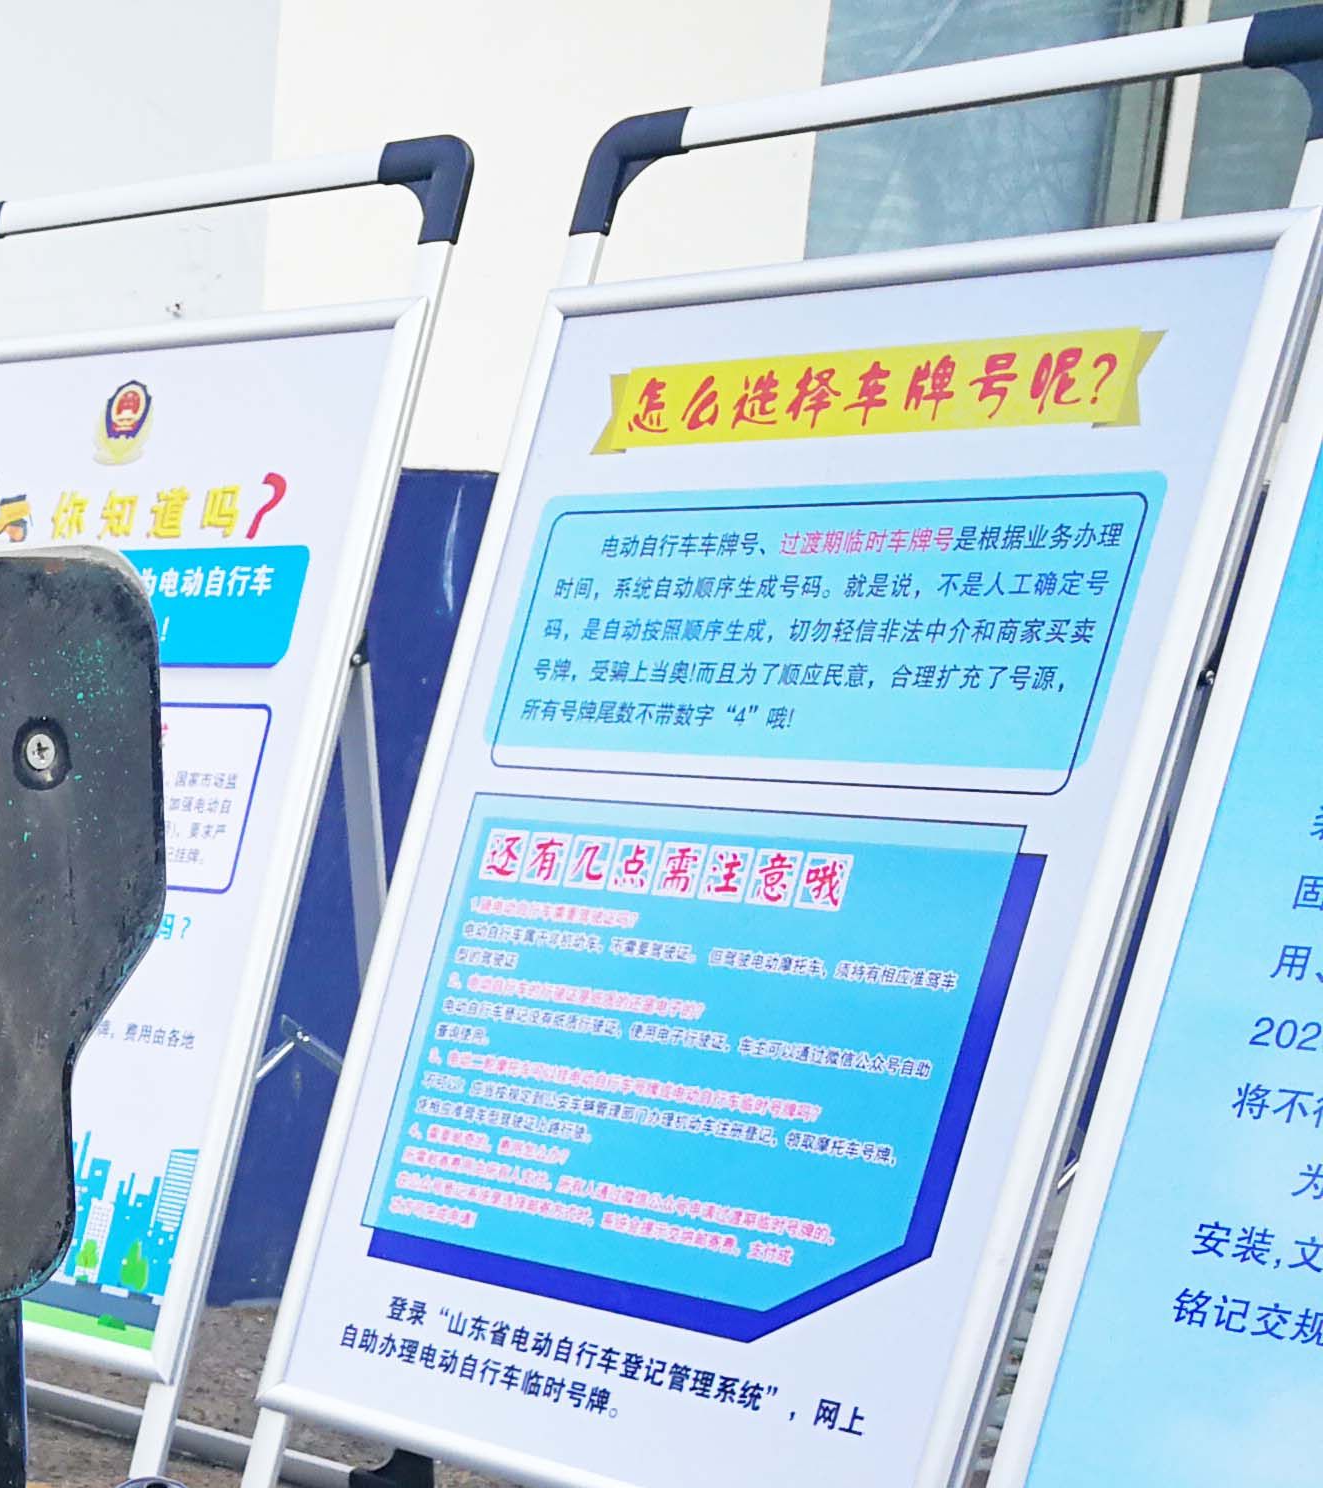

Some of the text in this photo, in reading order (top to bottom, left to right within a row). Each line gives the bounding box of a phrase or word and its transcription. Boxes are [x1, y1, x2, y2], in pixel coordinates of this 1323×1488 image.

[486, 836, 845, 907] 还有几点需注意哦
